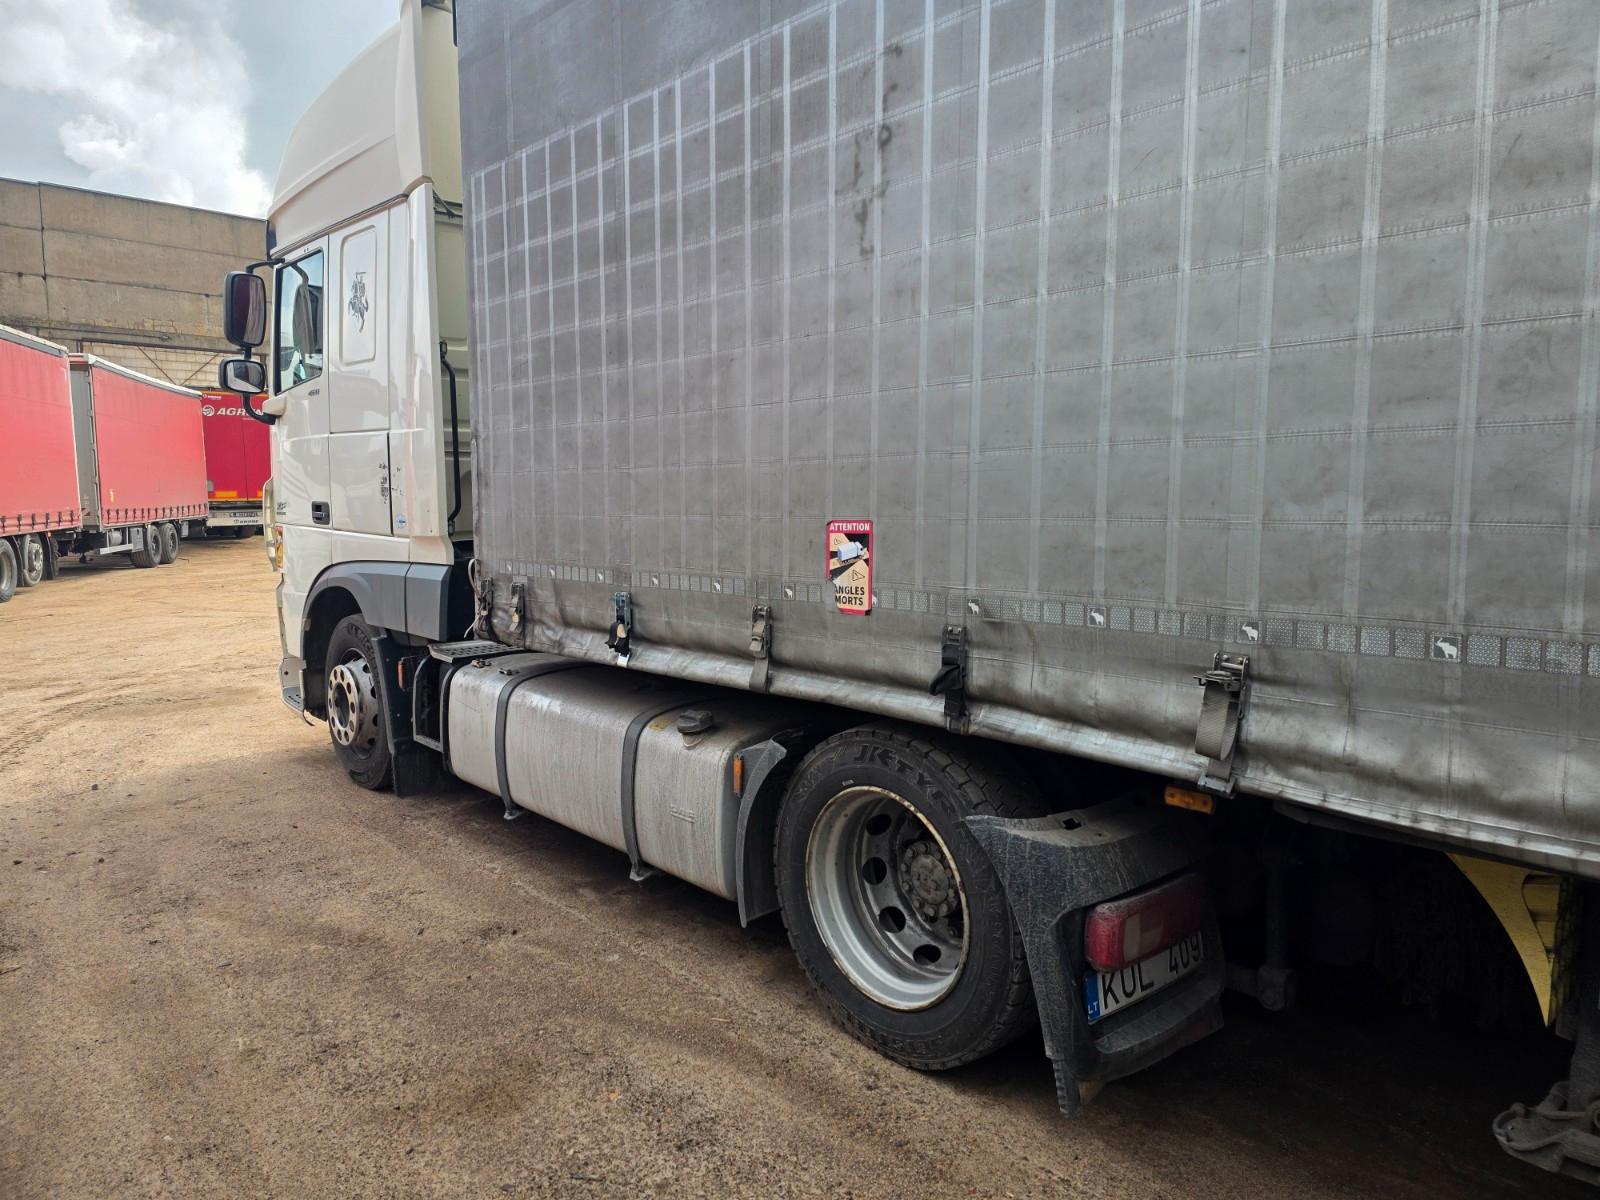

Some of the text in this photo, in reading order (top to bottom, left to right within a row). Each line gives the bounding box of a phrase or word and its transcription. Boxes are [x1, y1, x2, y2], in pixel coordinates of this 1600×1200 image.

[830, 522, 870, 531] ATTENTION
[835, 596, 864, 606] MORTS
[1101, 934, 1200, 1010] KUL 409
[1088, 1001, 1098, 1014] LT
